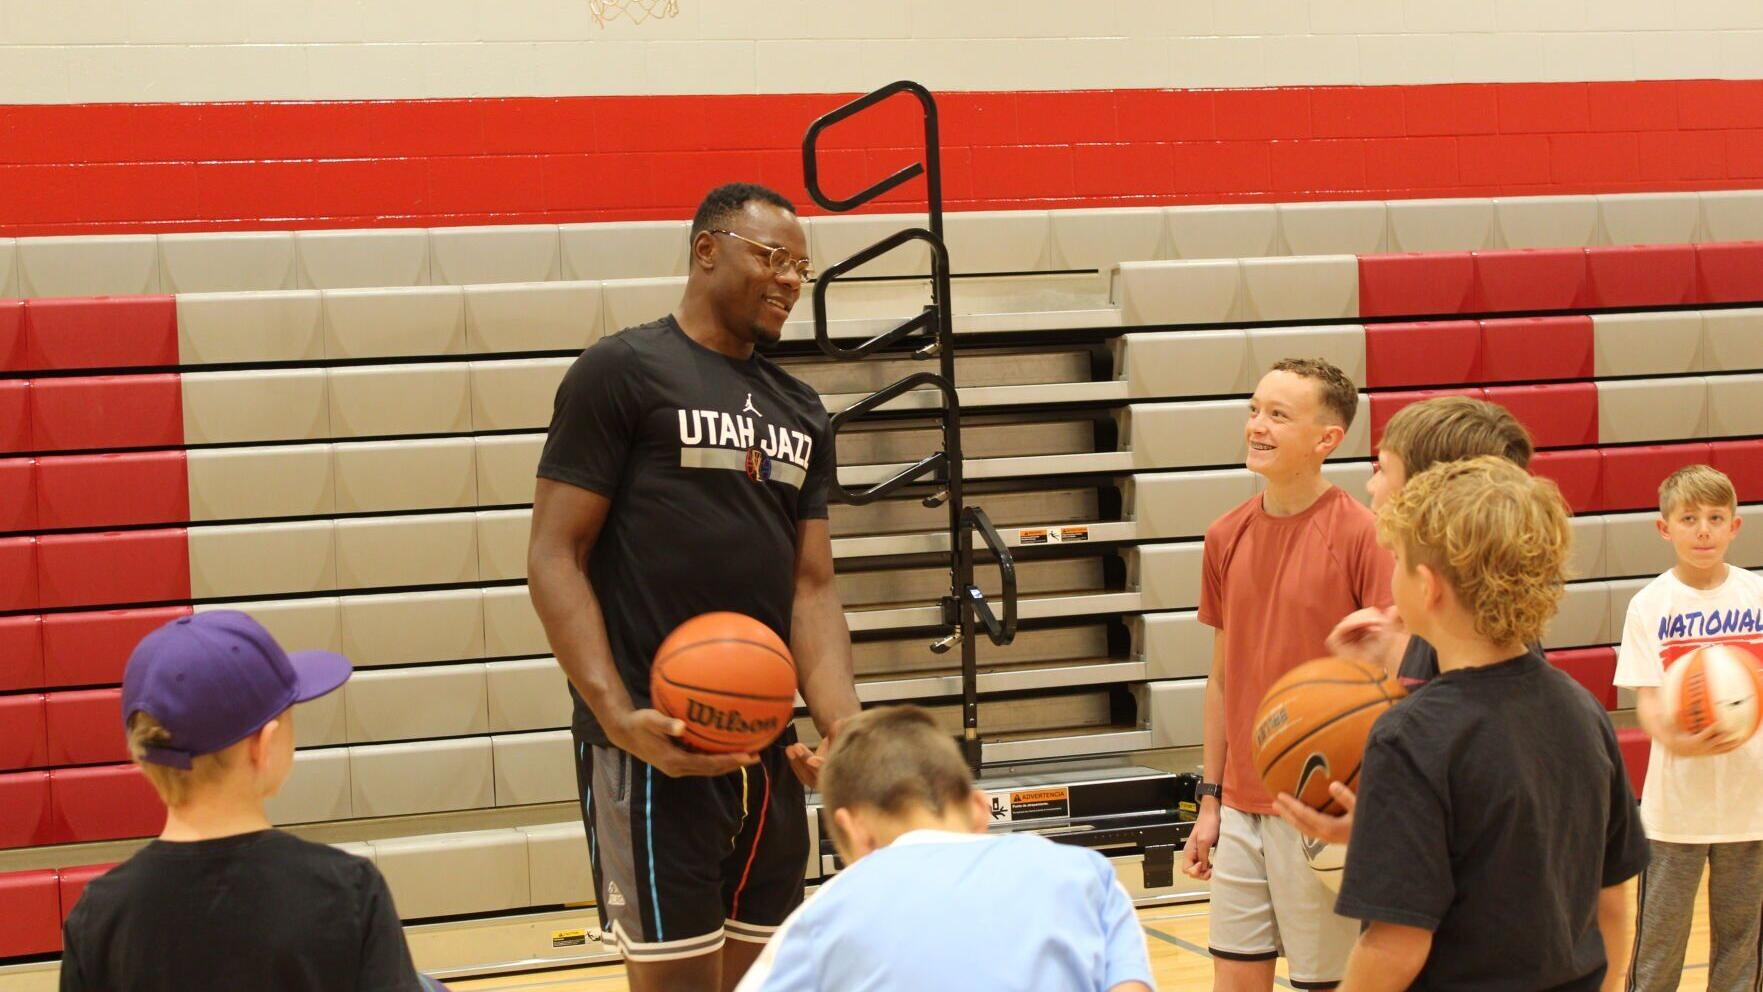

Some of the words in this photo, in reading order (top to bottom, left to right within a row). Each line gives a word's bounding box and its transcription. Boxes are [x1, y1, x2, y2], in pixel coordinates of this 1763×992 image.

[678, 409, 754, 449] UTAH
[761, 423, 813, 470] JAZZ
[1658, 608, 1763, 640] NATIONAL
[687, 697, 778, 733] Wilson
[1022, 791, 1065, 800] ADVERTENCIA
